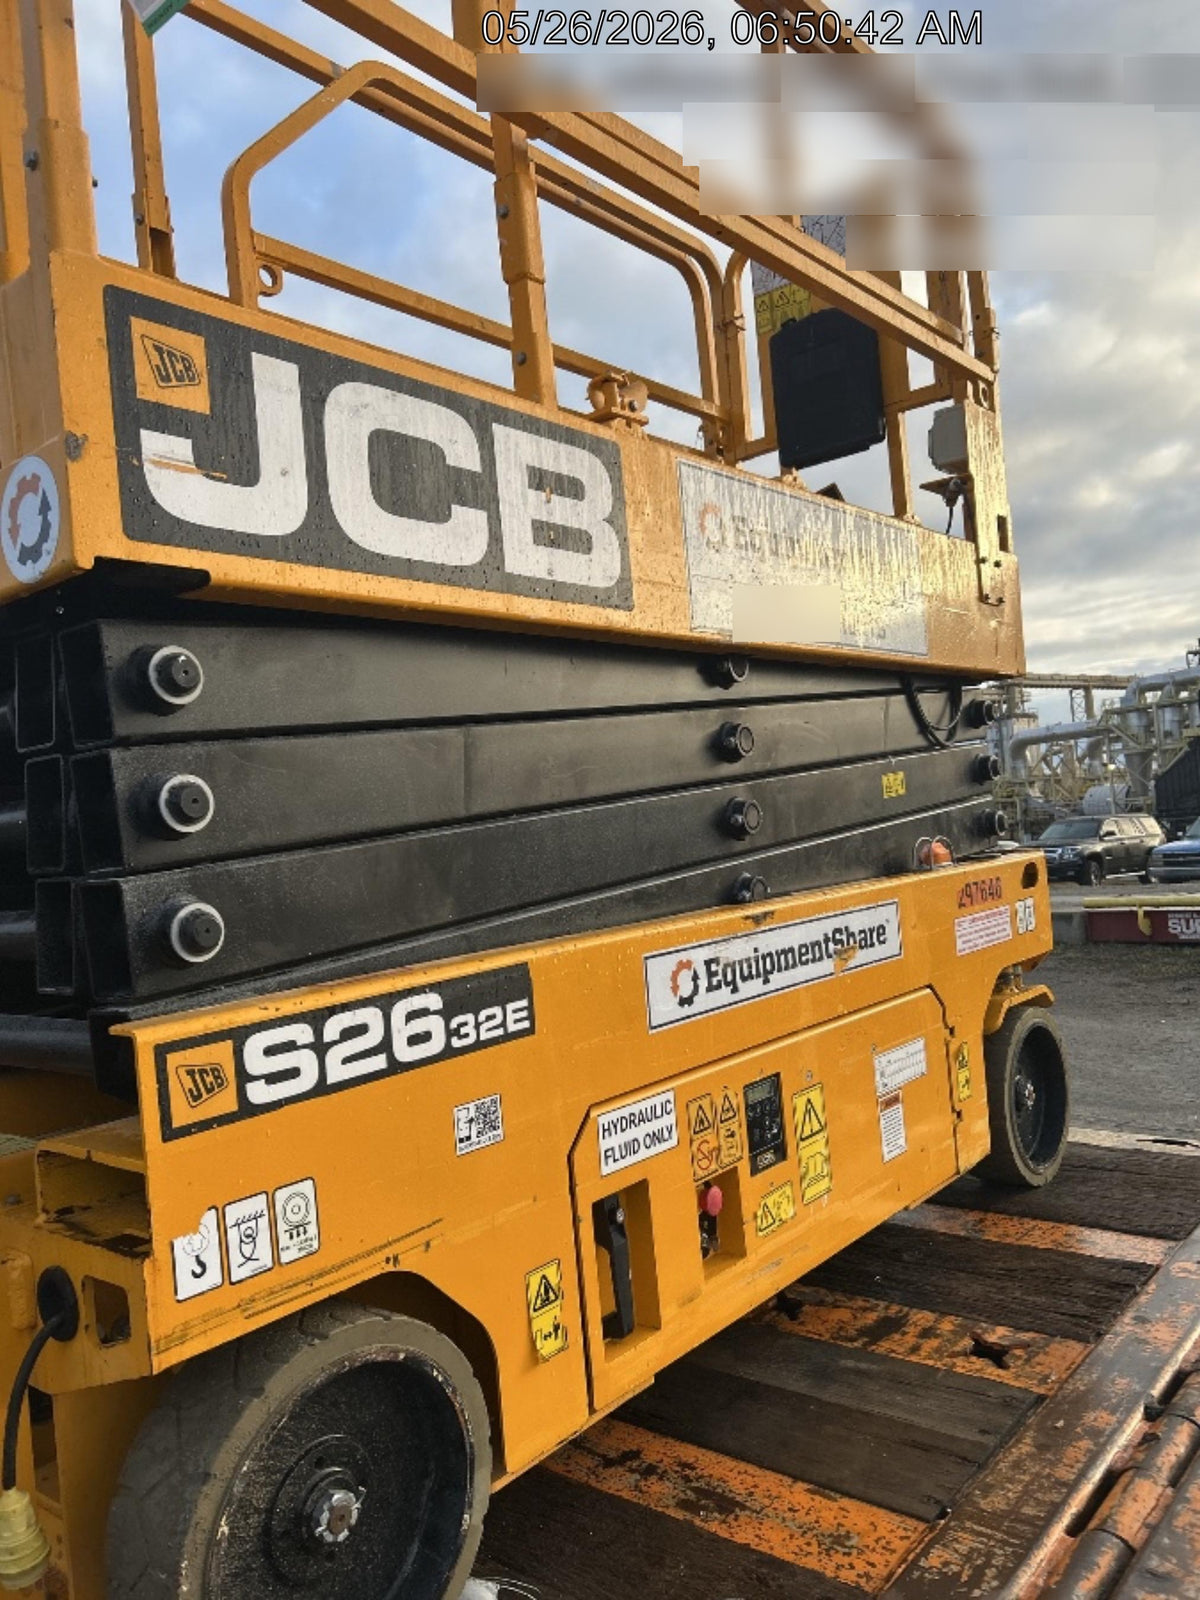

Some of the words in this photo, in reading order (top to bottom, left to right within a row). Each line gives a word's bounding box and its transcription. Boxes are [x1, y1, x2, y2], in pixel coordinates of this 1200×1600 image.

[152, 343, 197, 383] JCB
[140, 352, 621, 588] JCB
[704, 923, 888, 994] EquipmentShare
[185, 1066, 225, 1102] JCB
[602, 1099, 673, 1140] HYDRAULIC
[604, 1137, 641, 1166] FLUID
[643, 1123, 673, 1149] ONLY
